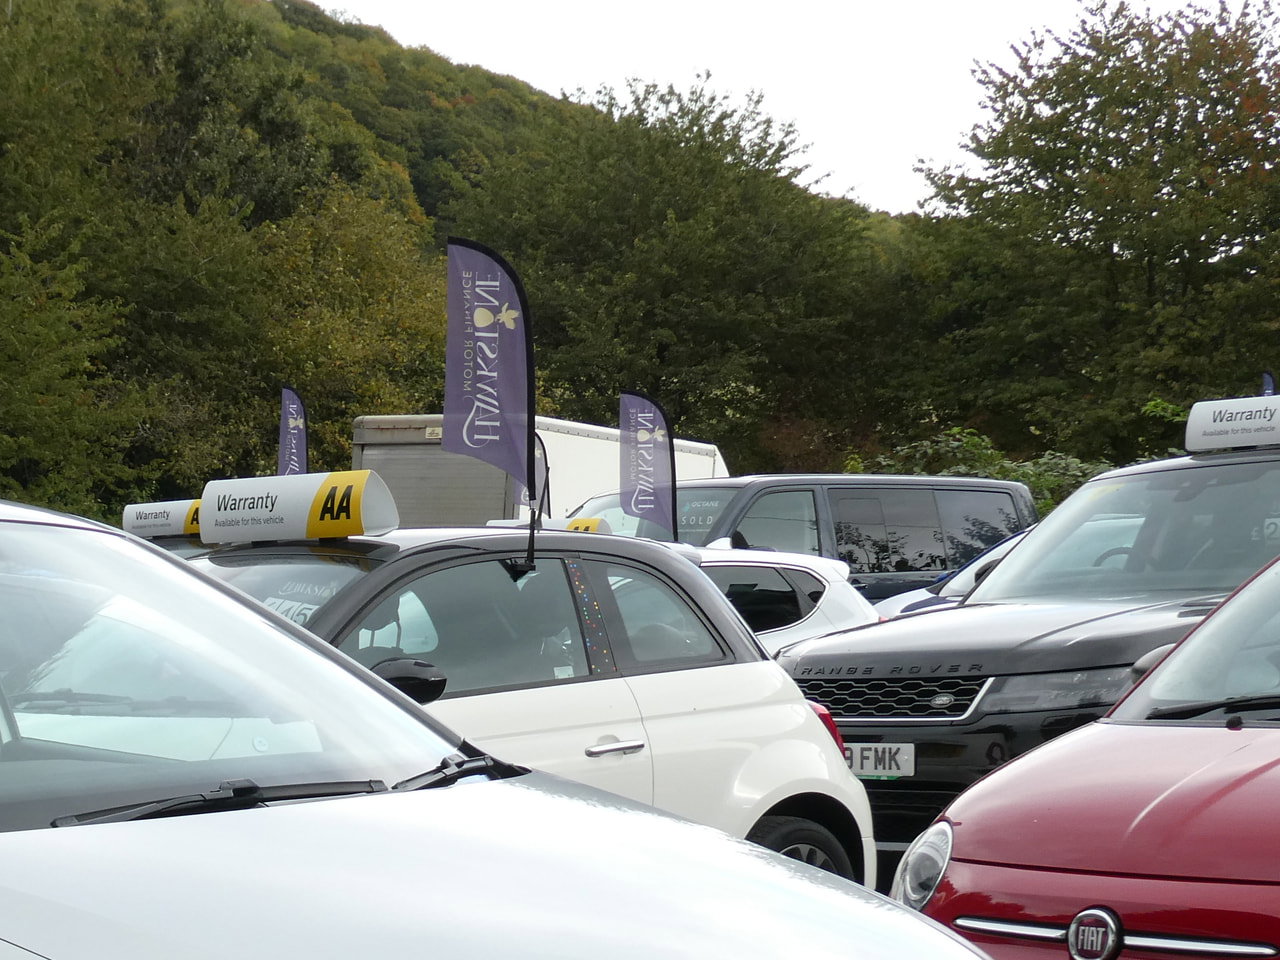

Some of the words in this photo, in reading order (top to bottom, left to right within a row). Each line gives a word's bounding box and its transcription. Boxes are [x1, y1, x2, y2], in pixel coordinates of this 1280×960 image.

[1212, 406, 1277, 423] Warranty
[216, 491, 278, 513] Warranty
[319, 485, 354, 521] AA
[135, 509, 171, 520] Warranty
[214, 517, 241, 528] Available
[241, 517, 250, 526] for
[250, 516, 264, 526] this
[264, 515, 284, 525] vehicle
[681, 515, 713, 526] SOLD
[800, 665, 876, 676] RANGE
[889, 663, 985, 675] ROVER
[860, 746, 902, 771] FMK
[1077, 926, 1106, 951] FIAT
